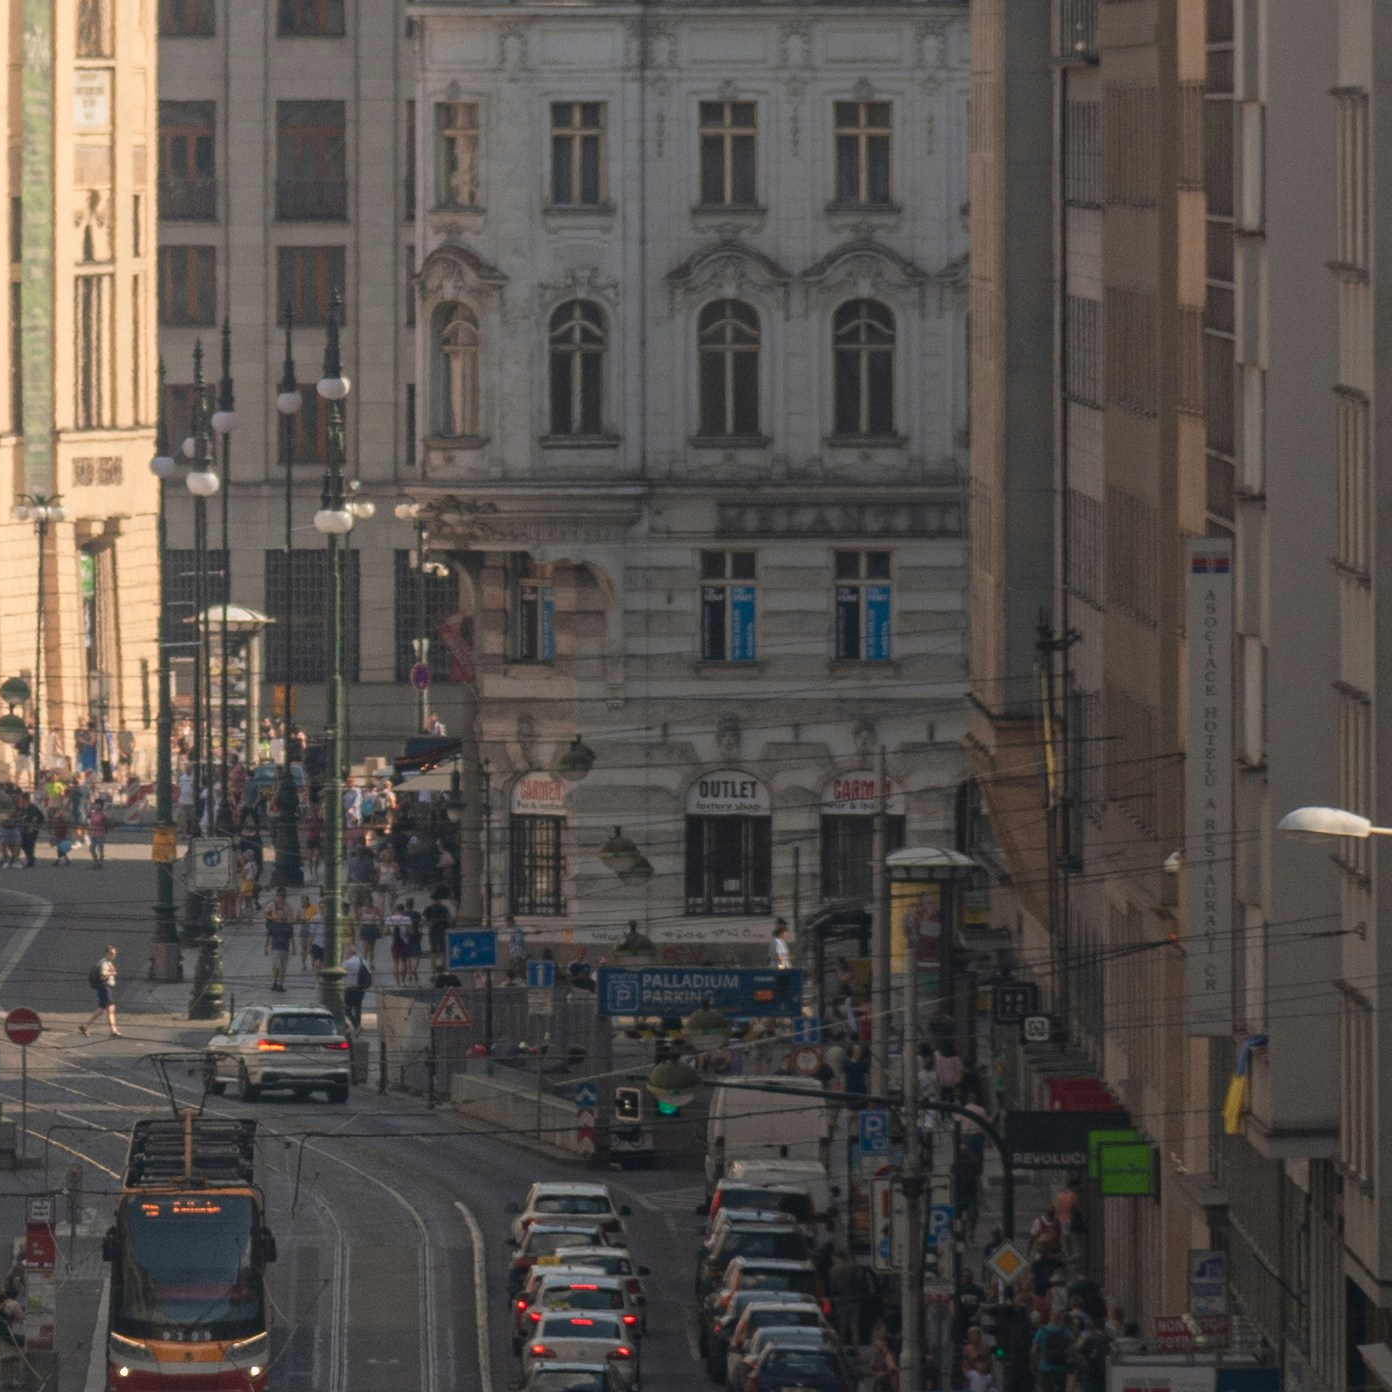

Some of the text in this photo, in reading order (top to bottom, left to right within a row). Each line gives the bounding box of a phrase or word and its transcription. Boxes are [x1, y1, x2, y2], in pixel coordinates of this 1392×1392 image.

[1204, 589, 1217, 697] ASOCIACE
[699, 780, 757, 798] OUTLET
[735, 801, 759, 813] shop
[642, 973, 739, 988] PALLADIUM
[642, 990, 715, 1004] PARKING
